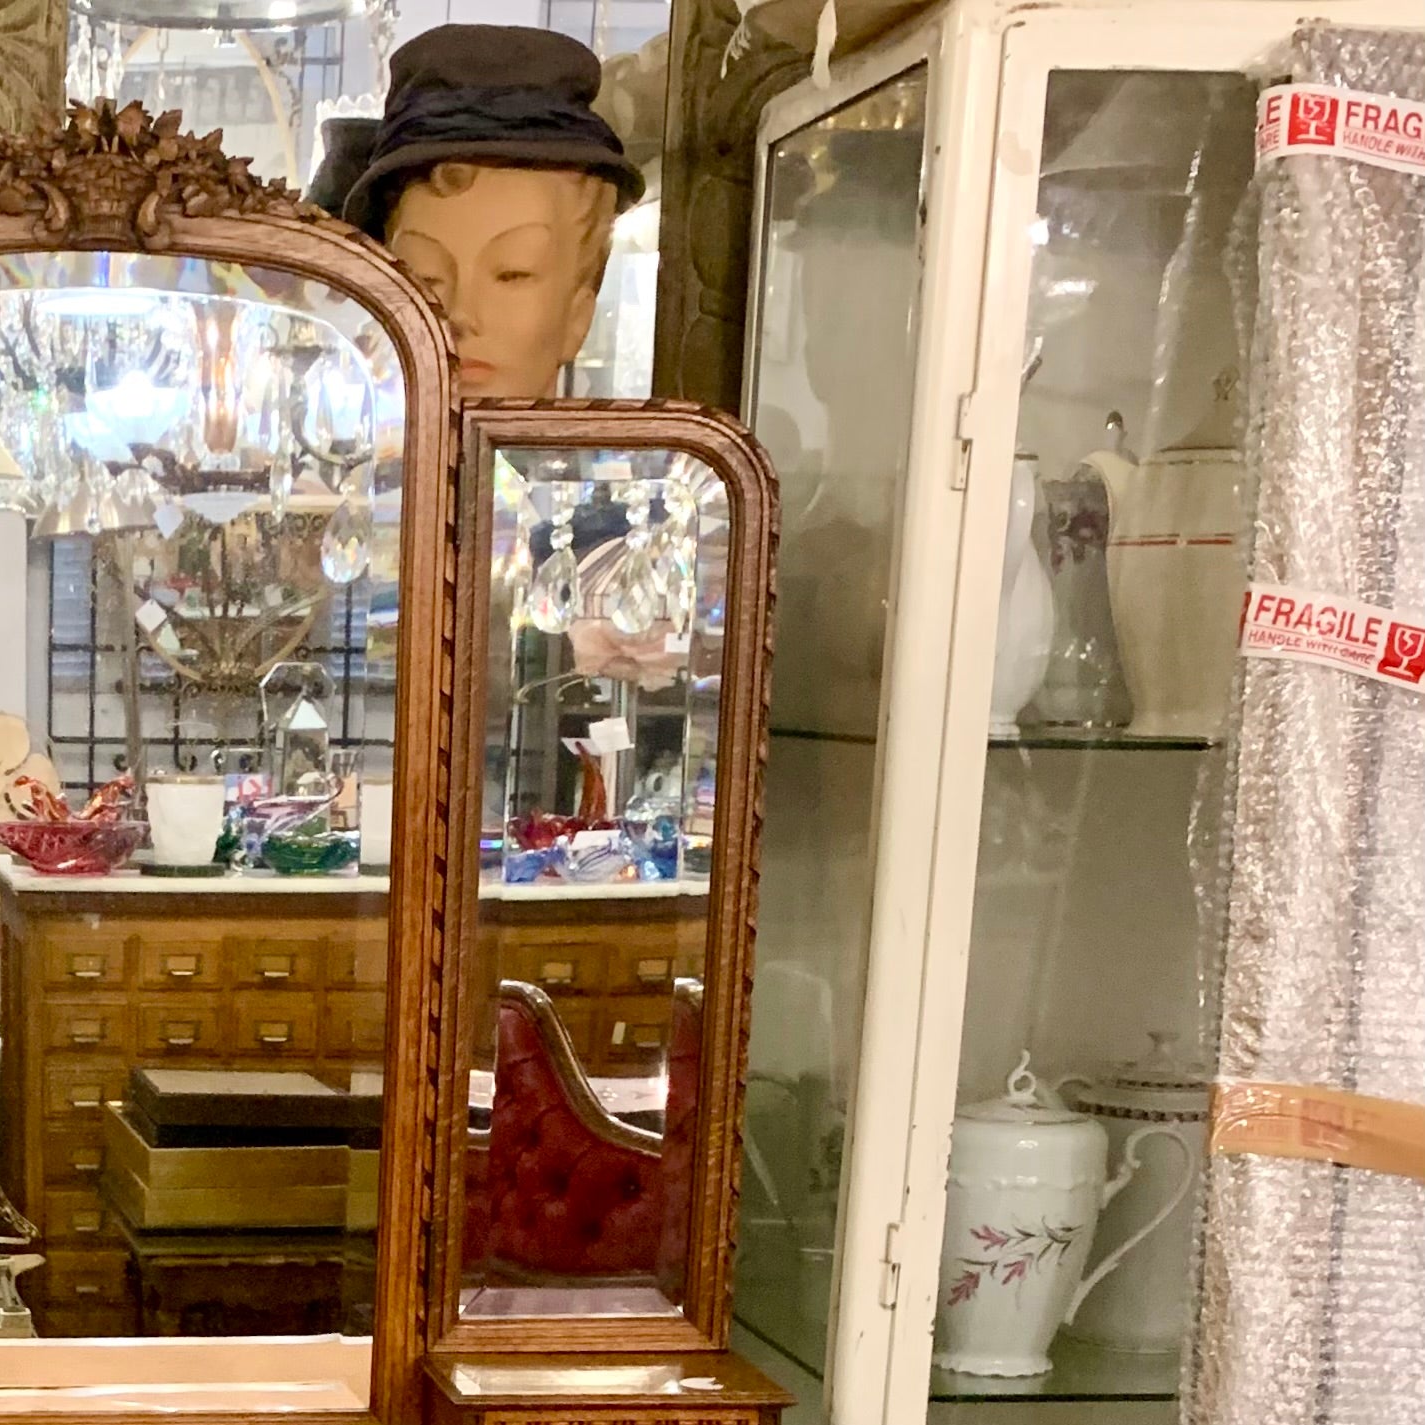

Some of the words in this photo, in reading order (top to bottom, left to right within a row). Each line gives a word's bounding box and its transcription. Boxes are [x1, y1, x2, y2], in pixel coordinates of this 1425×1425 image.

[1345, 101, 1423, 140] FRAG
[1343, 131, 1392, 154] HANDLE
[1253, 594, 1383, 648] FRAGILE
[1247, 630, 1302, 648] HANDLE
[1306, 639, 1339, 654] WITH
[1340, 648, 1376, 665] CARE
